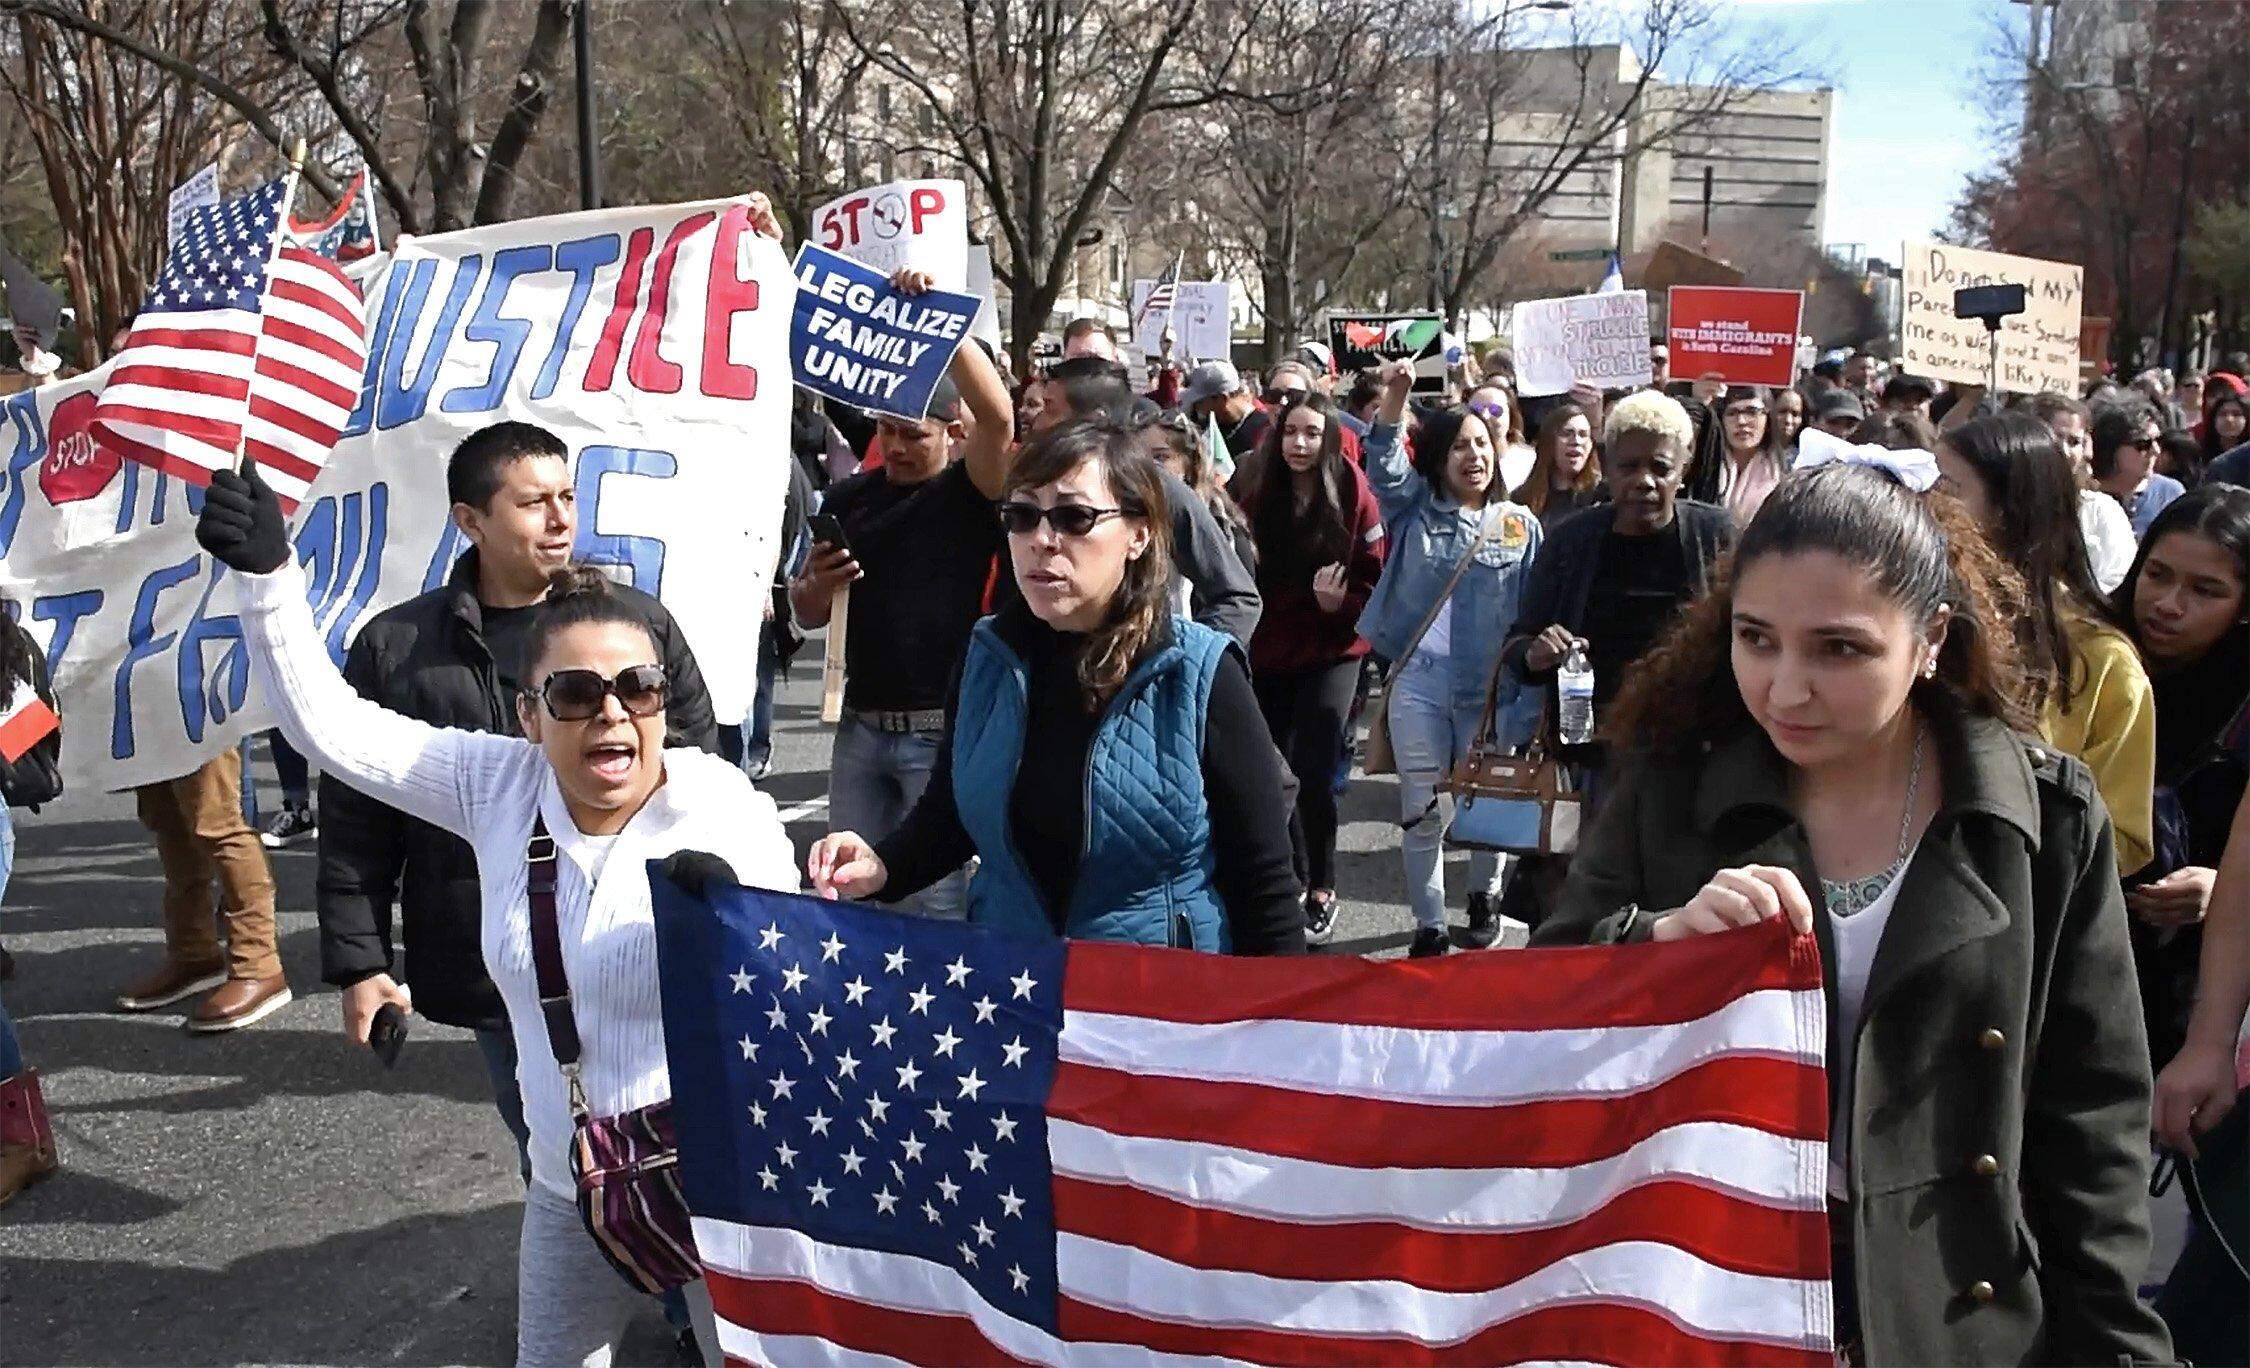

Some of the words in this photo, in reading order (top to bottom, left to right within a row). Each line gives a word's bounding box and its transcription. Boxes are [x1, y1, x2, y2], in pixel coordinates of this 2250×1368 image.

[1930, 249, 1956, 284] Do
[799, 263, 968, 340] LEGALIZE
[807, 306, 933, 368] FAMILY
[1697, 328, 1794, 345] IMMIGRANTS
[1906, 320, 1935, 342] me
[1720, 343, 1775, 356] Carolina
[803, 344, 909, 401] UNITY
